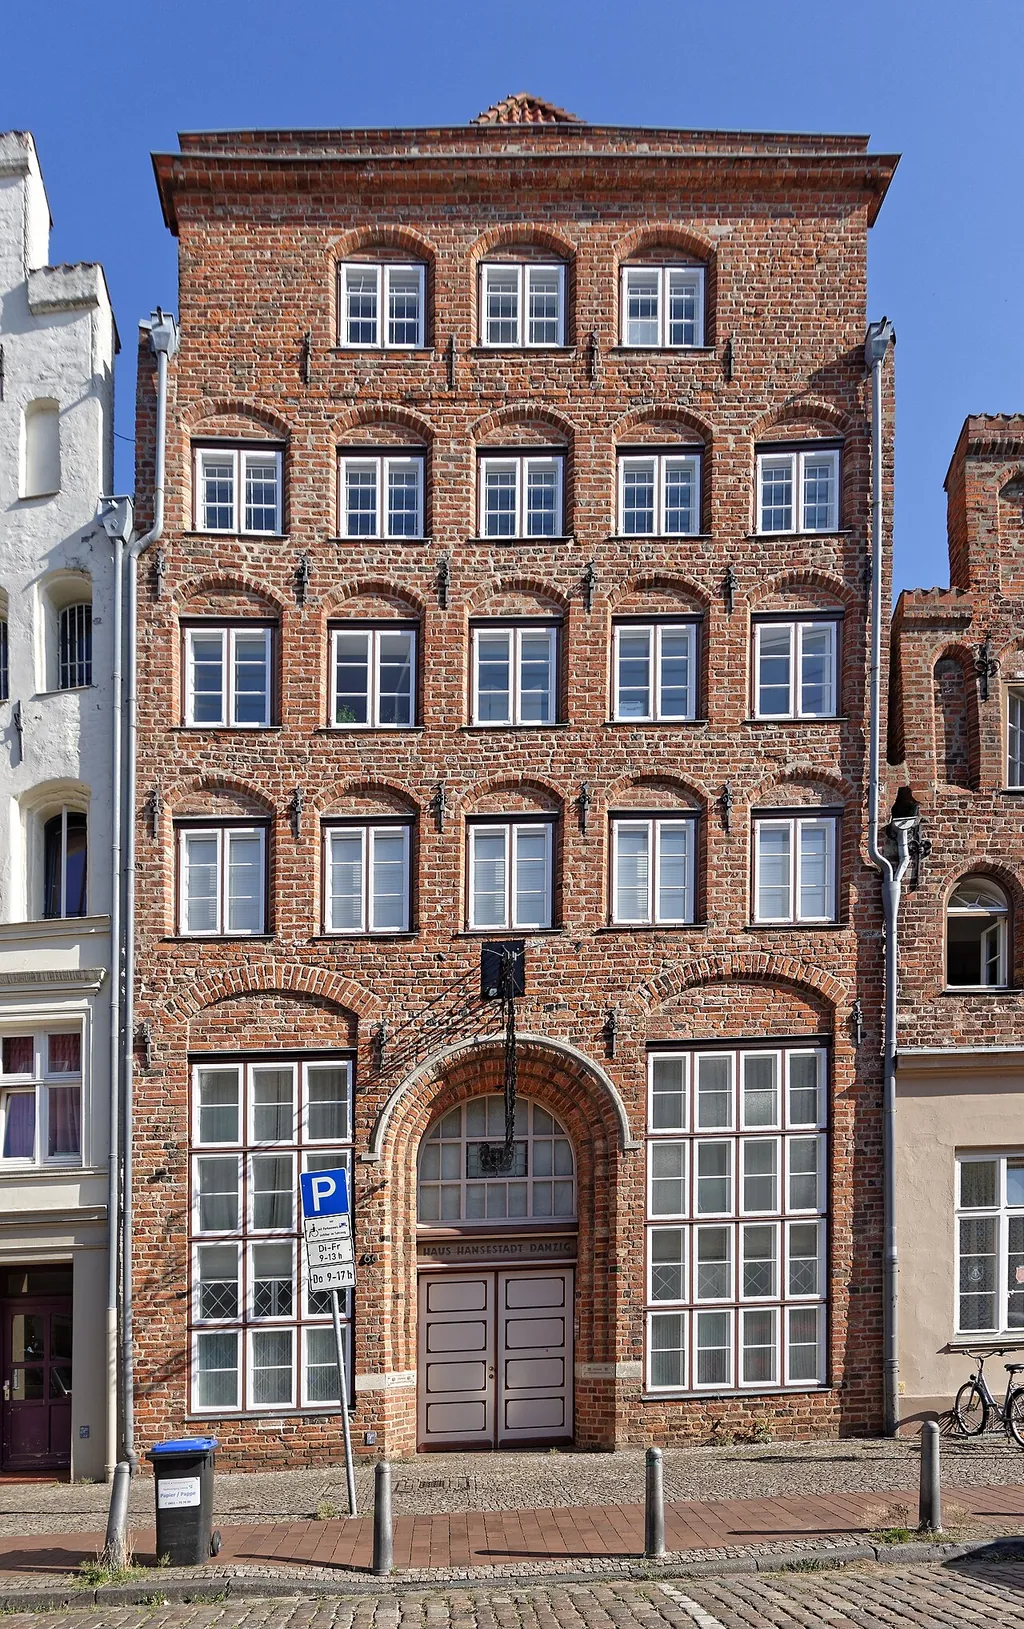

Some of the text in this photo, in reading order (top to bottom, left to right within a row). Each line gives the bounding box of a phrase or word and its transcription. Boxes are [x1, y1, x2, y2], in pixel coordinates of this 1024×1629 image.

[312, 1176, 336, 1212] P
[318, 1242, 341, 1253] Di-Fr
[423, 1242, 571, 1256] HAUS HANSESTADT DANZIG
[319, 1252, 343, 1262] 9-13 h
[312, 1269, 353, 1284] Do 9-17 h
